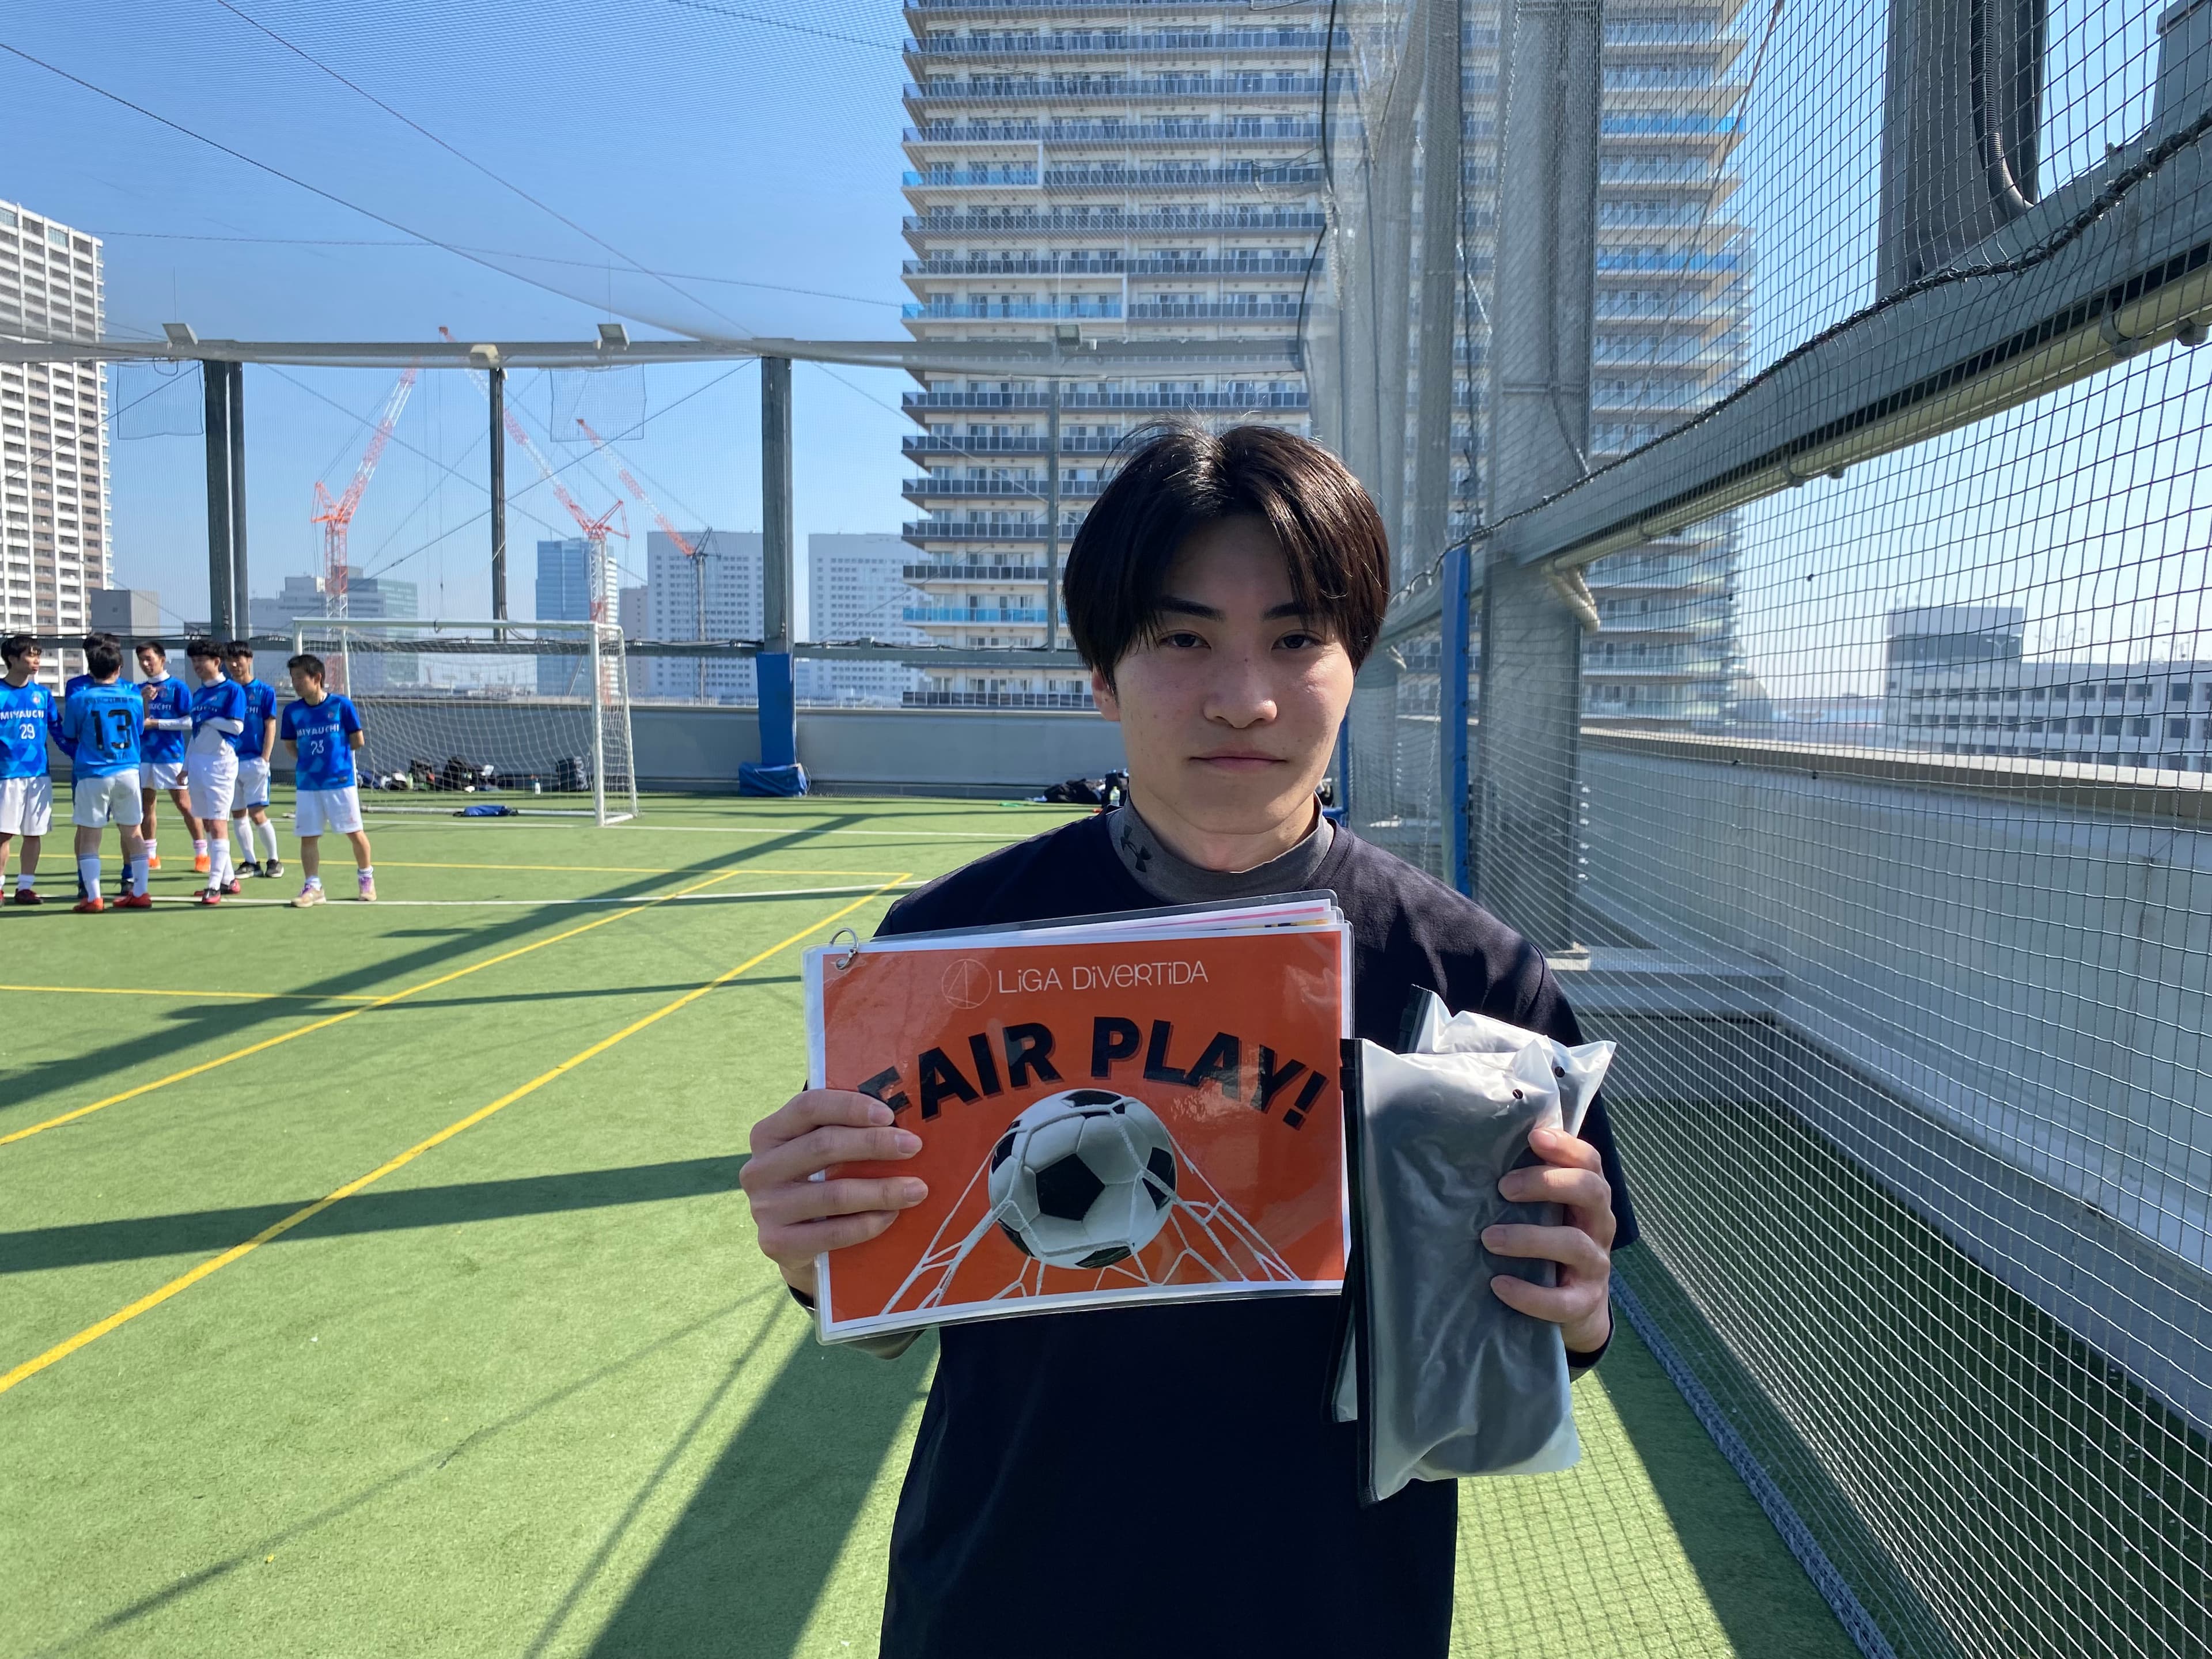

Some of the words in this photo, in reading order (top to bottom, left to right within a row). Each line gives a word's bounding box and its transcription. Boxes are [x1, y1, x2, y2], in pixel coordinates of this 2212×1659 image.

[0, 709, 44, 721] MIYAUCHI
[19, 723, 35, 740] 29
[90, 709, 132, 751] 13
[296, 724, 339, 737] MIYAUCHI
[857, 1022, 1065, 1127] FAIR
[1090, 1016, 1330, 1131] PLAY!
